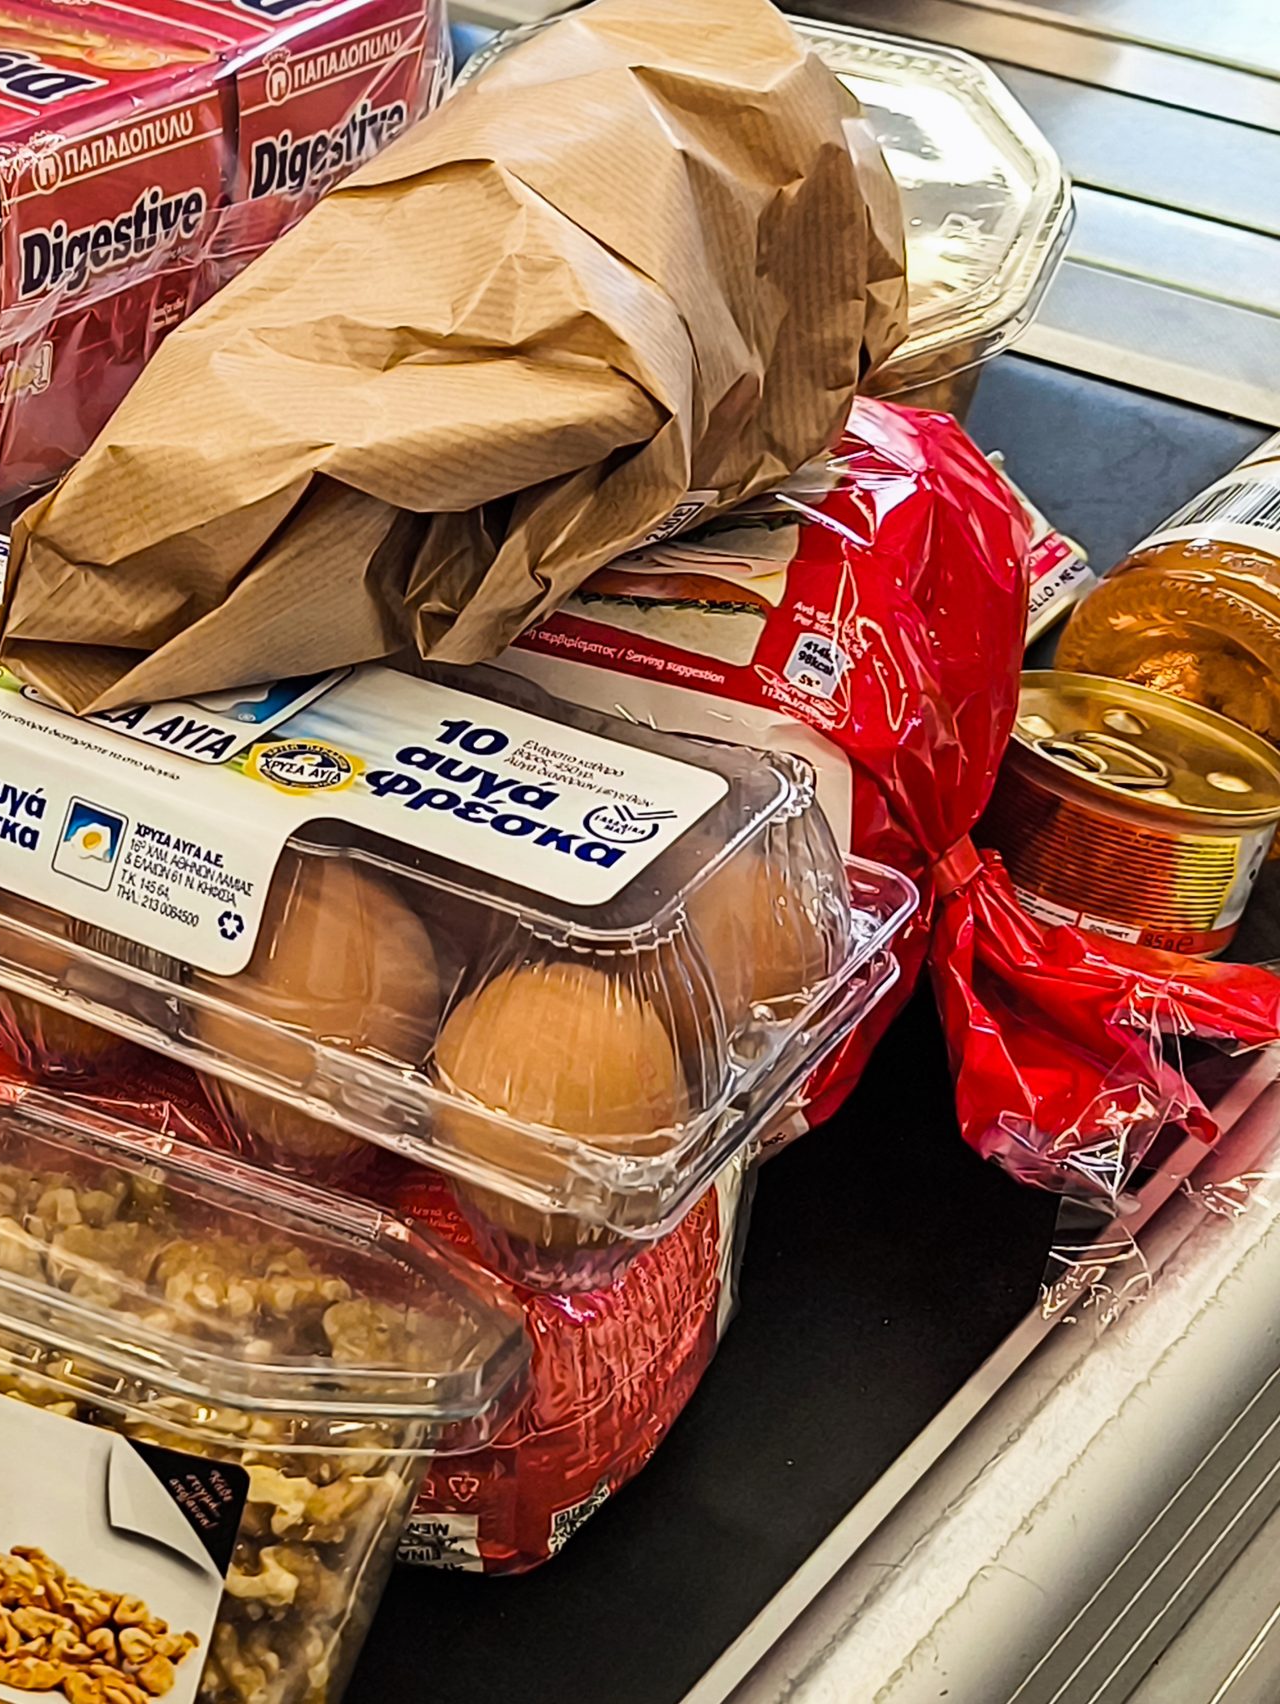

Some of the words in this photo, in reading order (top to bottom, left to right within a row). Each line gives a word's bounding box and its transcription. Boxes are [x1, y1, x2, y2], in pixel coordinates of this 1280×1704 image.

[22, 190, 204, 297] Digestive
[625, 650, 665, 670] Serving
[666, 661, 726, 685] suggestion
[143, 715, 240, 760] ΑΥΓΑ
[438, 718, 508, 757] 10
[261, 758, 305, 776] ΧΡΥΣΑ
[395, 747, 561, 811] αυγά
[365, 768, 627, 870] φρέσκα
[134, 822, 170, 848] ΧΡΥΣΑ
[172, 837, 201, 860] ΑΥΓΑ
[141, 895, 159, 913] 213
